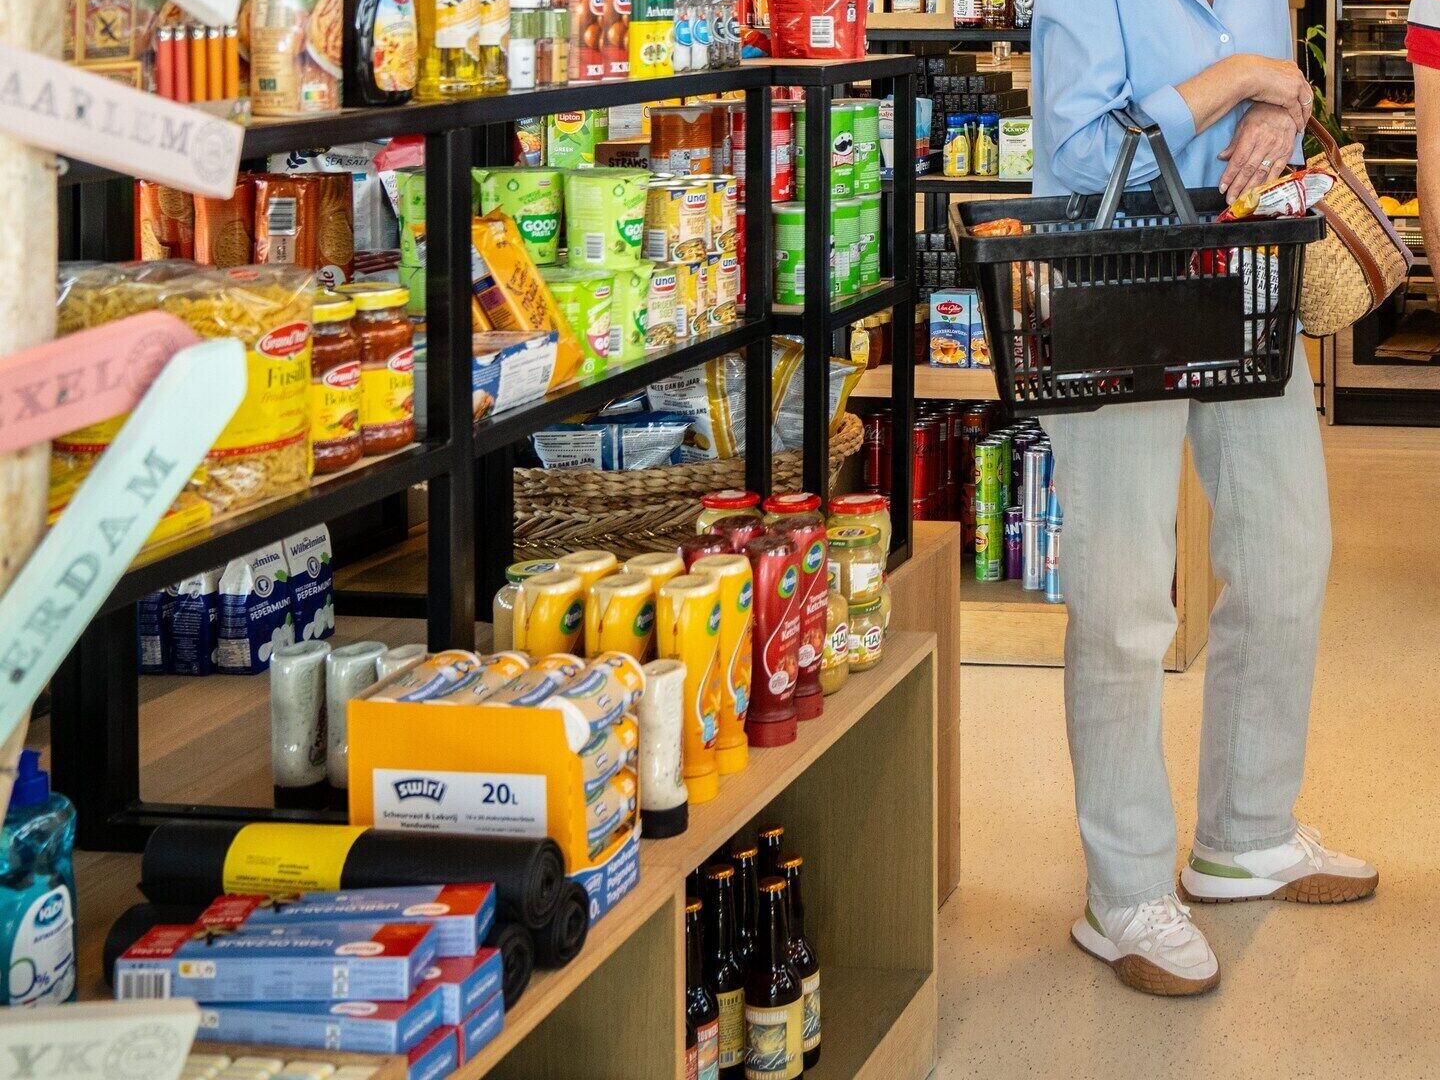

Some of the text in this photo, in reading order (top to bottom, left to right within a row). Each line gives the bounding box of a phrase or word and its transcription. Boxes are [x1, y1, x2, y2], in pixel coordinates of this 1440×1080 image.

[0, 71, 194, 156] AARLEM
[559, 112, 582, 122] Lipton
[325, 156, 370, 168] SEA SALT
[608, 157, 648, 169] STRAWS
[522, 218, 557, 233] GOOD
[13, 357, 122, 421] XEL
[290, 533, 327, 557] Wilhelmina
[0, 446, 177, 686] ERDAM
[253, 551, 281, 571] elmina
[296, 576, 332, 602] PEPERMUNT
[250, 596, 291, 622] PEPERMUNT
[397, 779, 444, 803] swirl
